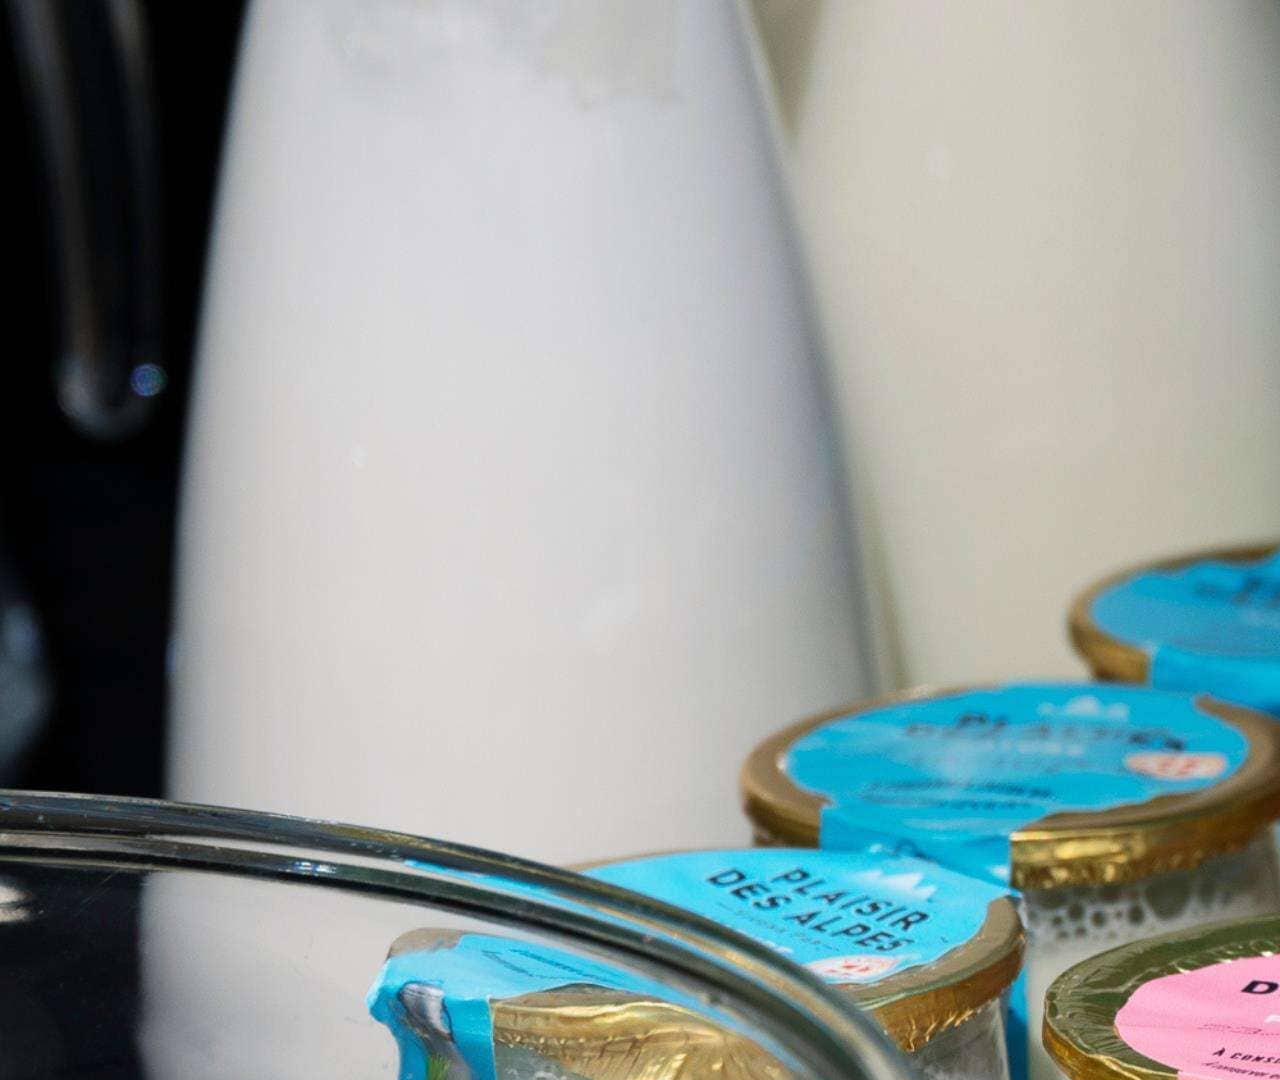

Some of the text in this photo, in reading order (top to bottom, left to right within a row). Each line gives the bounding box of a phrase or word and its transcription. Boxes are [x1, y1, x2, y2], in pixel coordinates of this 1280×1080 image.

[706, 869, 791, 911] DES
[784, 911, 914, 952] ALPES
[770, 868, 929, 931] PLAISIR
